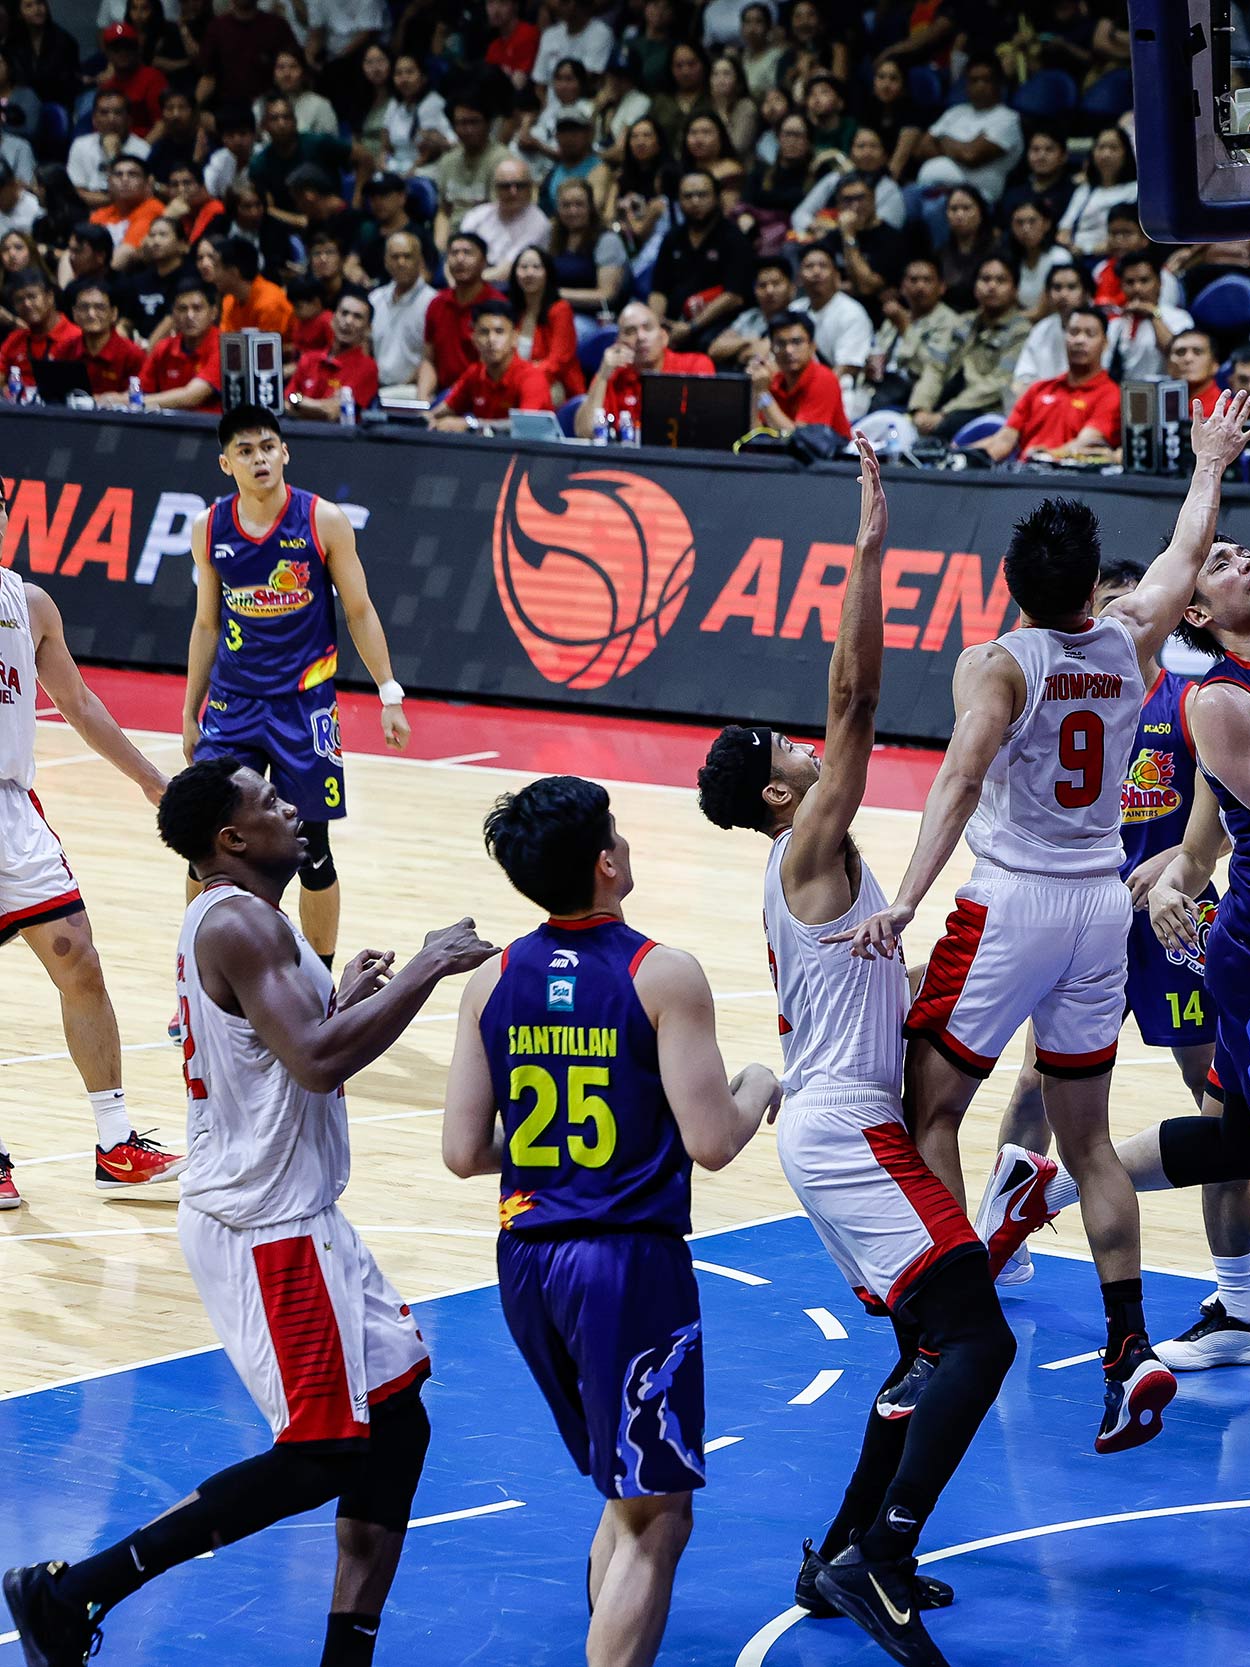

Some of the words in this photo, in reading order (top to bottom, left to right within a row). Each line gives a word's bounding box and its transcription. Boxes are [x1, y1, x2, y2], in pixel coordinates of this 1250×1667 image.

[699, 536, 1032, 652] AREN
[225, 619, 244, 652] 3
[1043, 672, 1123, 701] THOMPSON
[1054, 710, 1105, 809] 9
[324, 776, 341, 807] 3
[1122, 809, 1158, 818] AINTERS
[1165, 990, 1204, 1028] 14
[508, 1025, 617, 1058] SANTILLAN
[509, 1064, 617, 1169] 25
